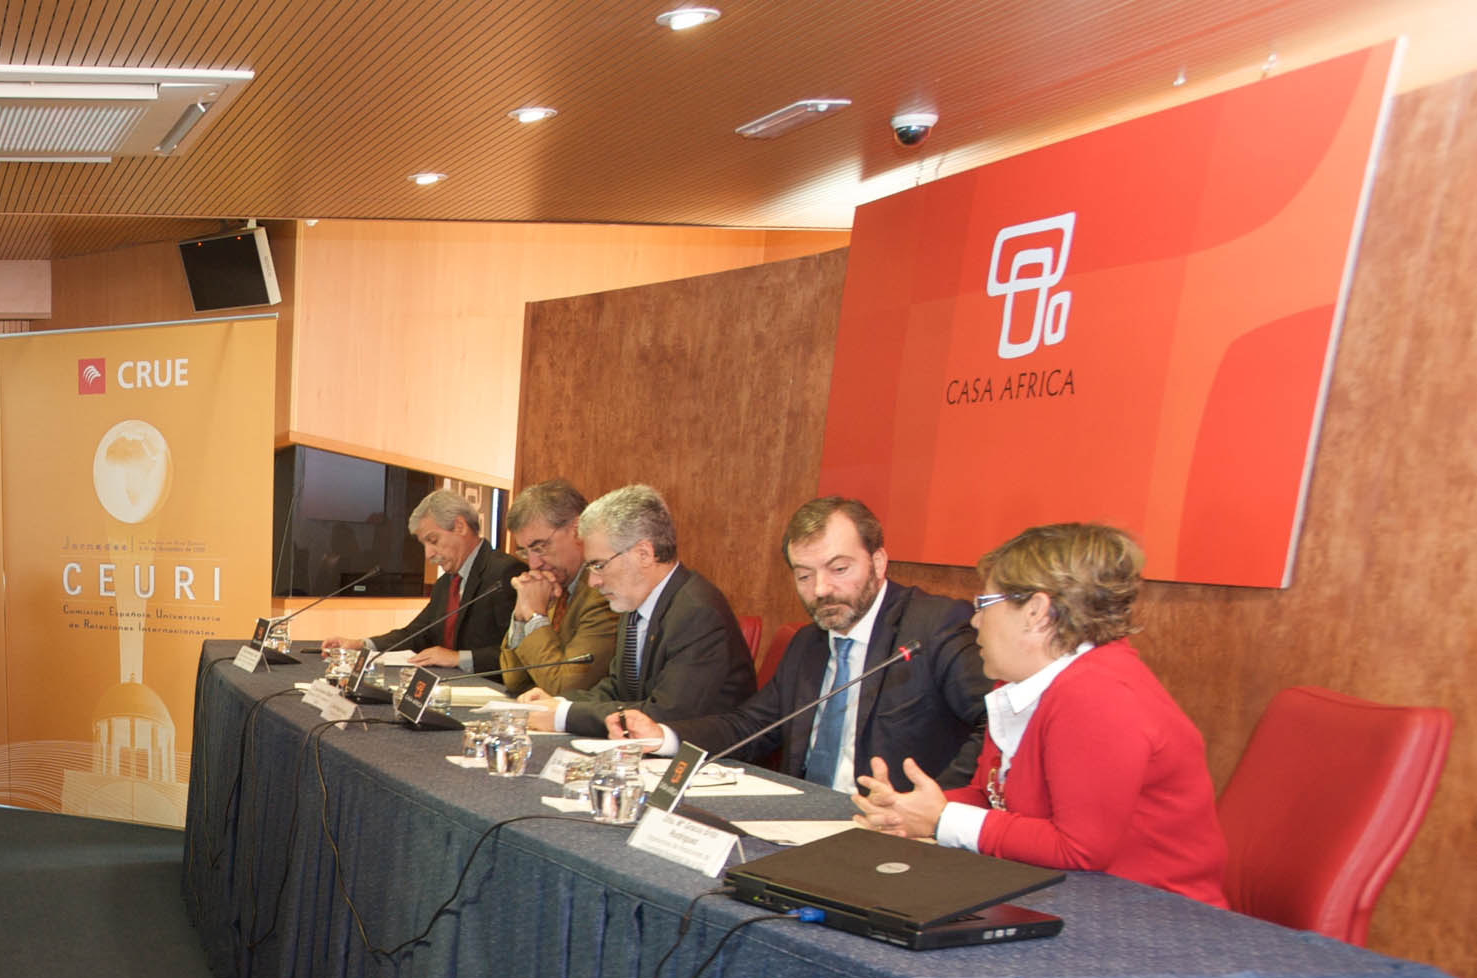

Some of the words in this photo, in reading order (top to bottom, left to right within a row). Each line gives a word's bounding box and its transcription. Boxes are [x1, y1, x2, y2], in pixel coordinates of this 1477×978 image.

[117, 358, 189, 390] CRUE
[946, 376, 994, 406] CASA
[999, 368, 1075, 401] AFRICA
[62, 562, 221, 601] CEURI
